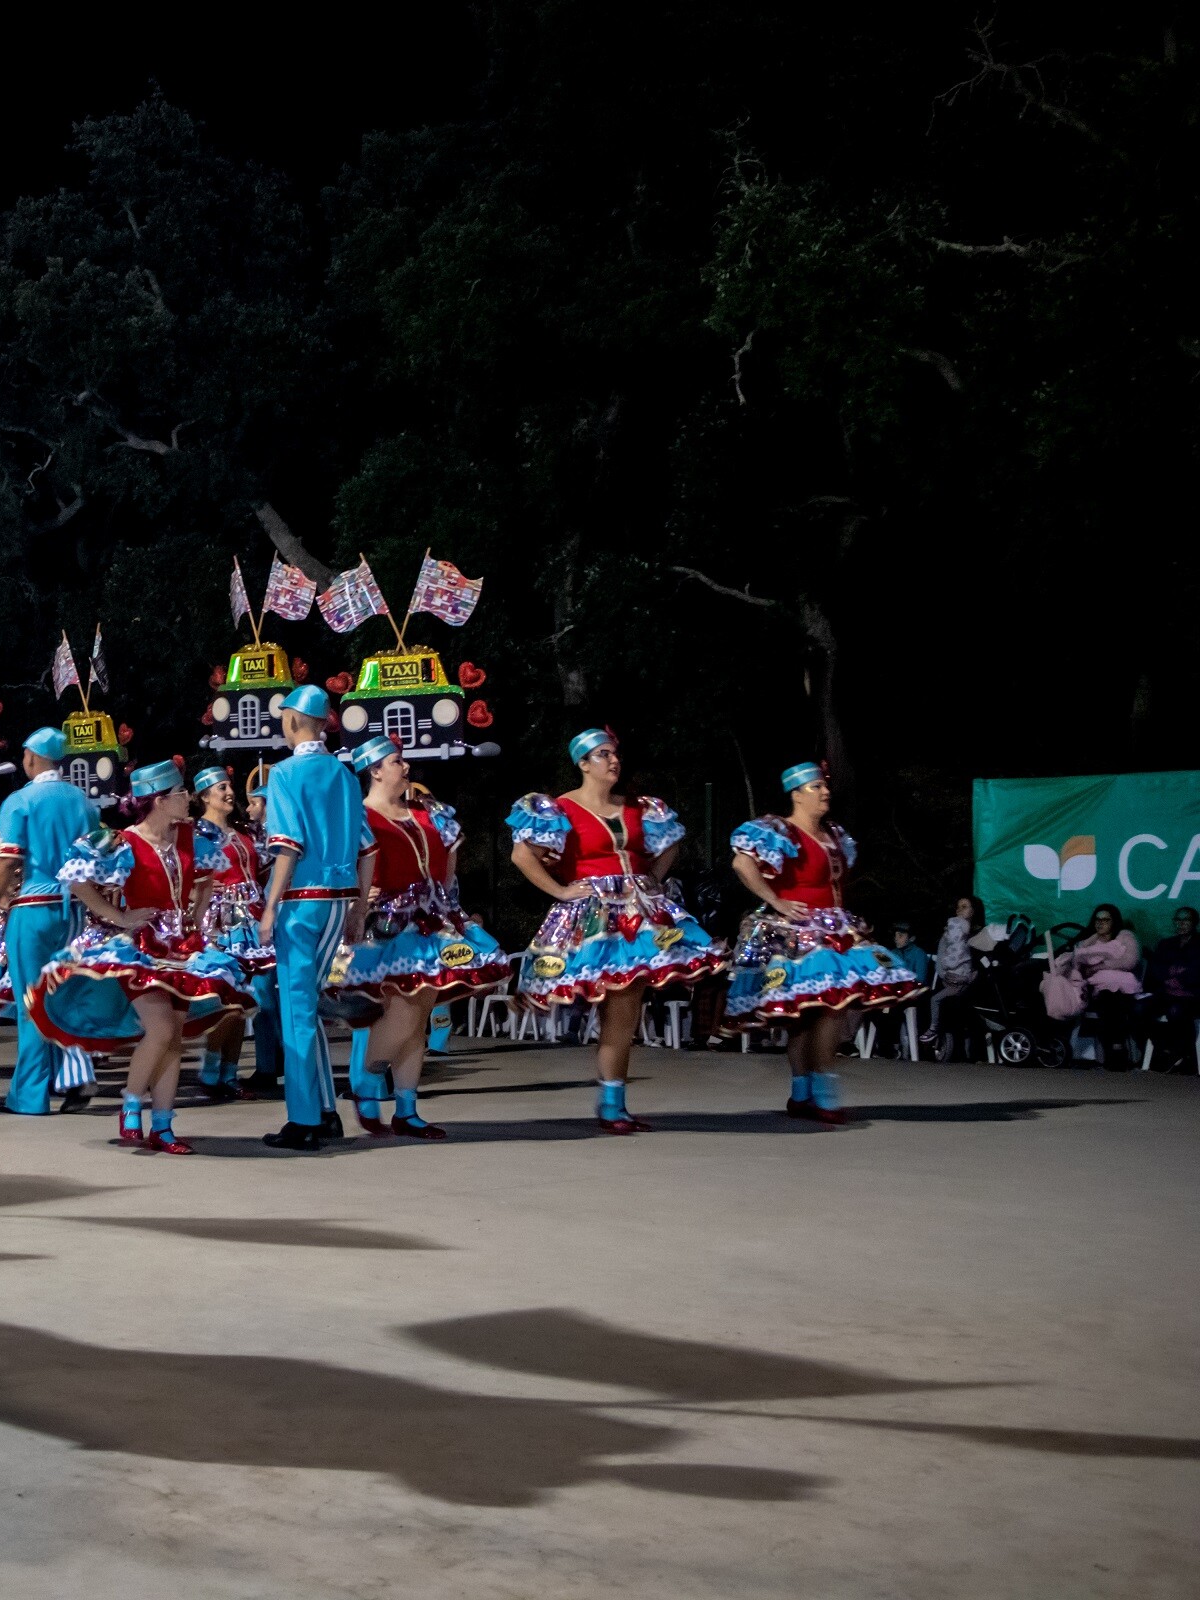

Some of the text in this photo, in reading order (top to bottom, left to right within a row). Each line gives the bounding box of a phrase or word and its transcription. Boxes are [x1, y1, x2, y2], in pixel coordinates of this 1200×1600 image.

[244, 659, 265, 671] TAXI
[384, 663, 417, 677] TAXI
[74, 725, 93, 736] TAXI
